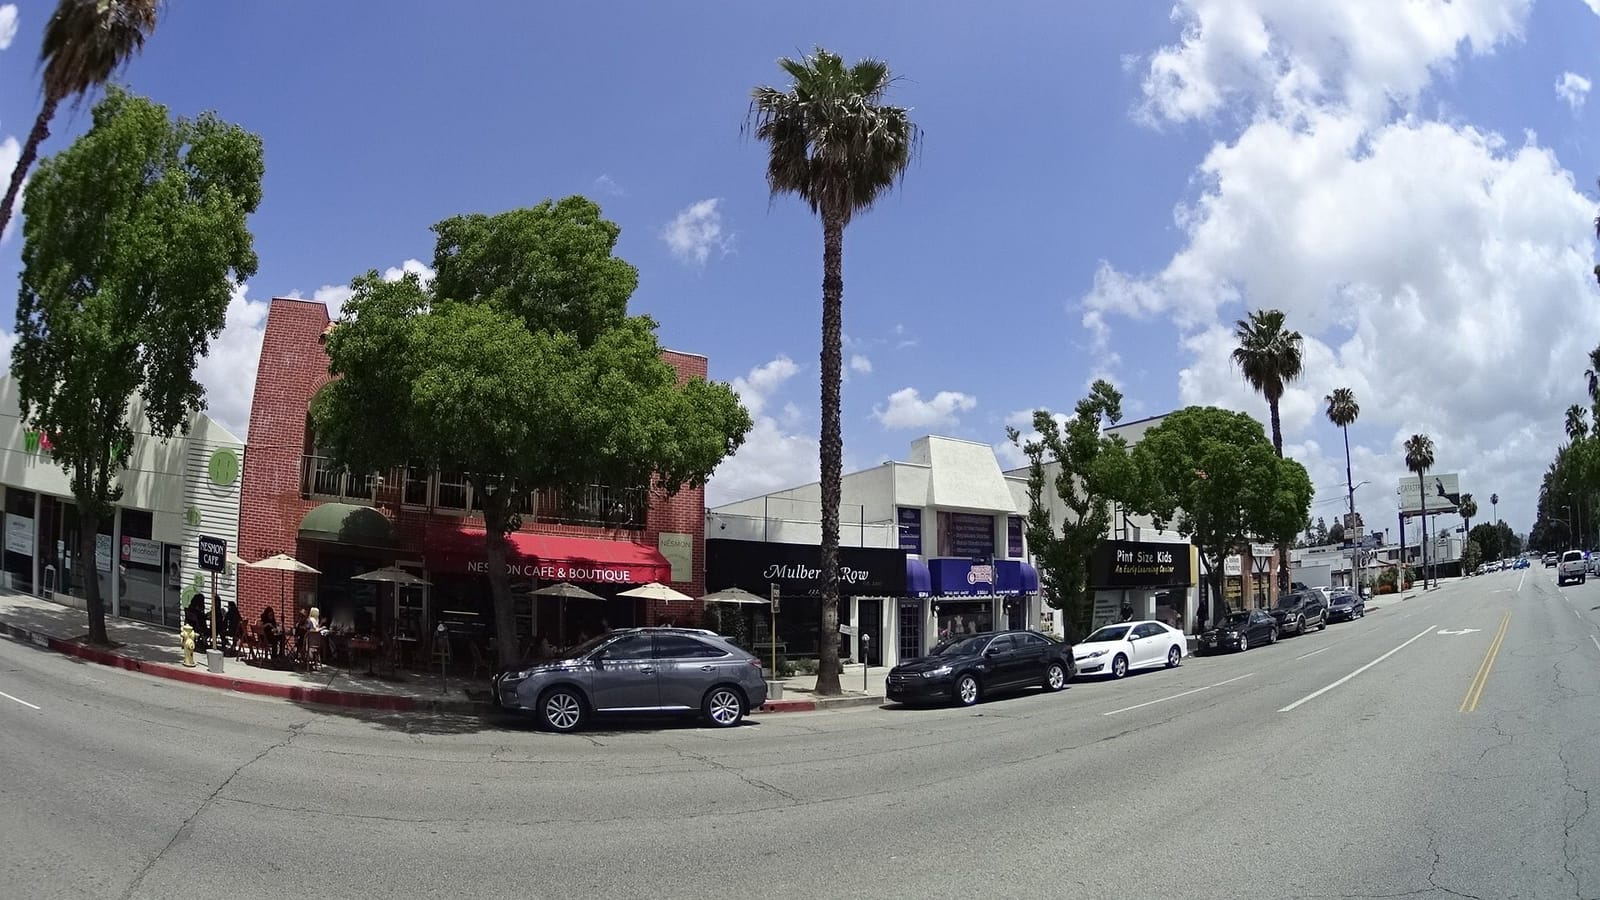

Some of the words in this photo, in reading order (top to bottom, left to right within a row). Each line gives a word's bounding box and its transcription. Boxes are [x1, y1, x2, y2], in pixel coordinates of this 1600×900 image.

[200, 541, 224, 555] NESMON
[204, 554, 219, 566] CAFE
[1117, 549, 1133, 562] Pint
[1137, 551, 1154, 563] Size
[1157, 551, 1173, 563] Kids
[468, 561, 521, 575] NESON
[524, 565, 555, 578] CAFE
[557, 567, 566, 578] &
[569, 568, 630, 581] BOUTIQUE
[763, 564, 838, 580] Mulber
[840, 566, 869, 584] Row
